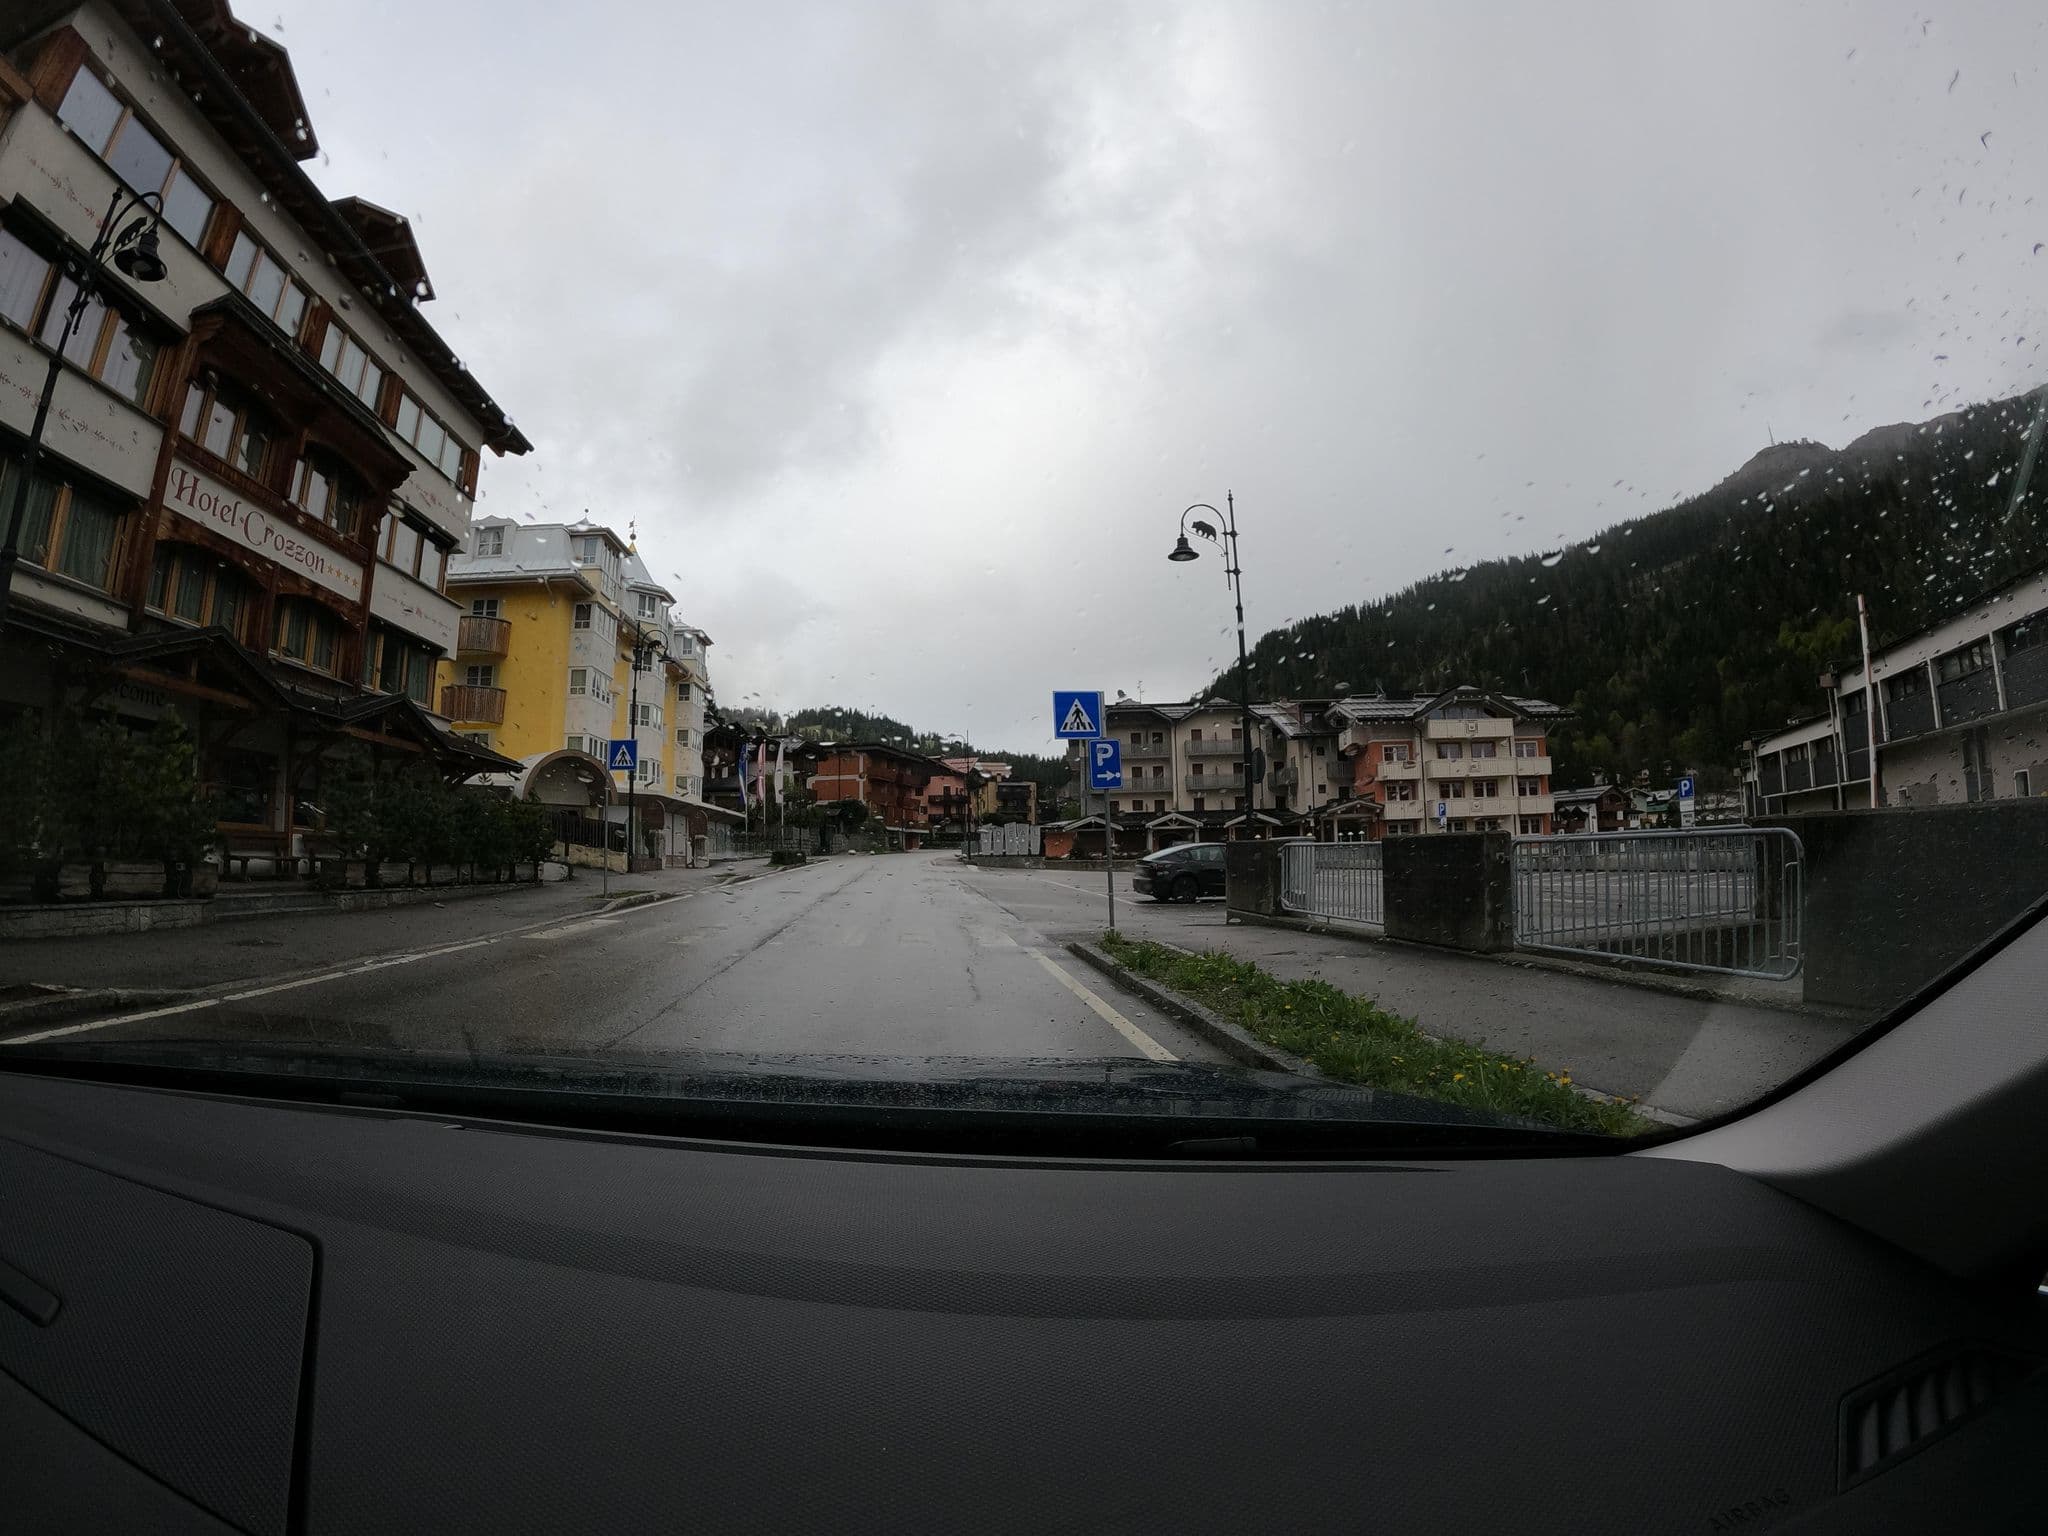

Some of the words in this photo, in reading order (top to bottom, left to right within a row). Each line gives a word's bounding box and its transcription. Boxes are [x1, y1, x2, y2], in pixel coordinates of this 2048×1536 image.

[170, 467, 242, 527] Hotel
[243, 510, 325, 574] Crozzon
[1096, 743, 1113, 767] P
[1681, 780, 1690, 796] P
[1440, 804, 1445, 815] P
